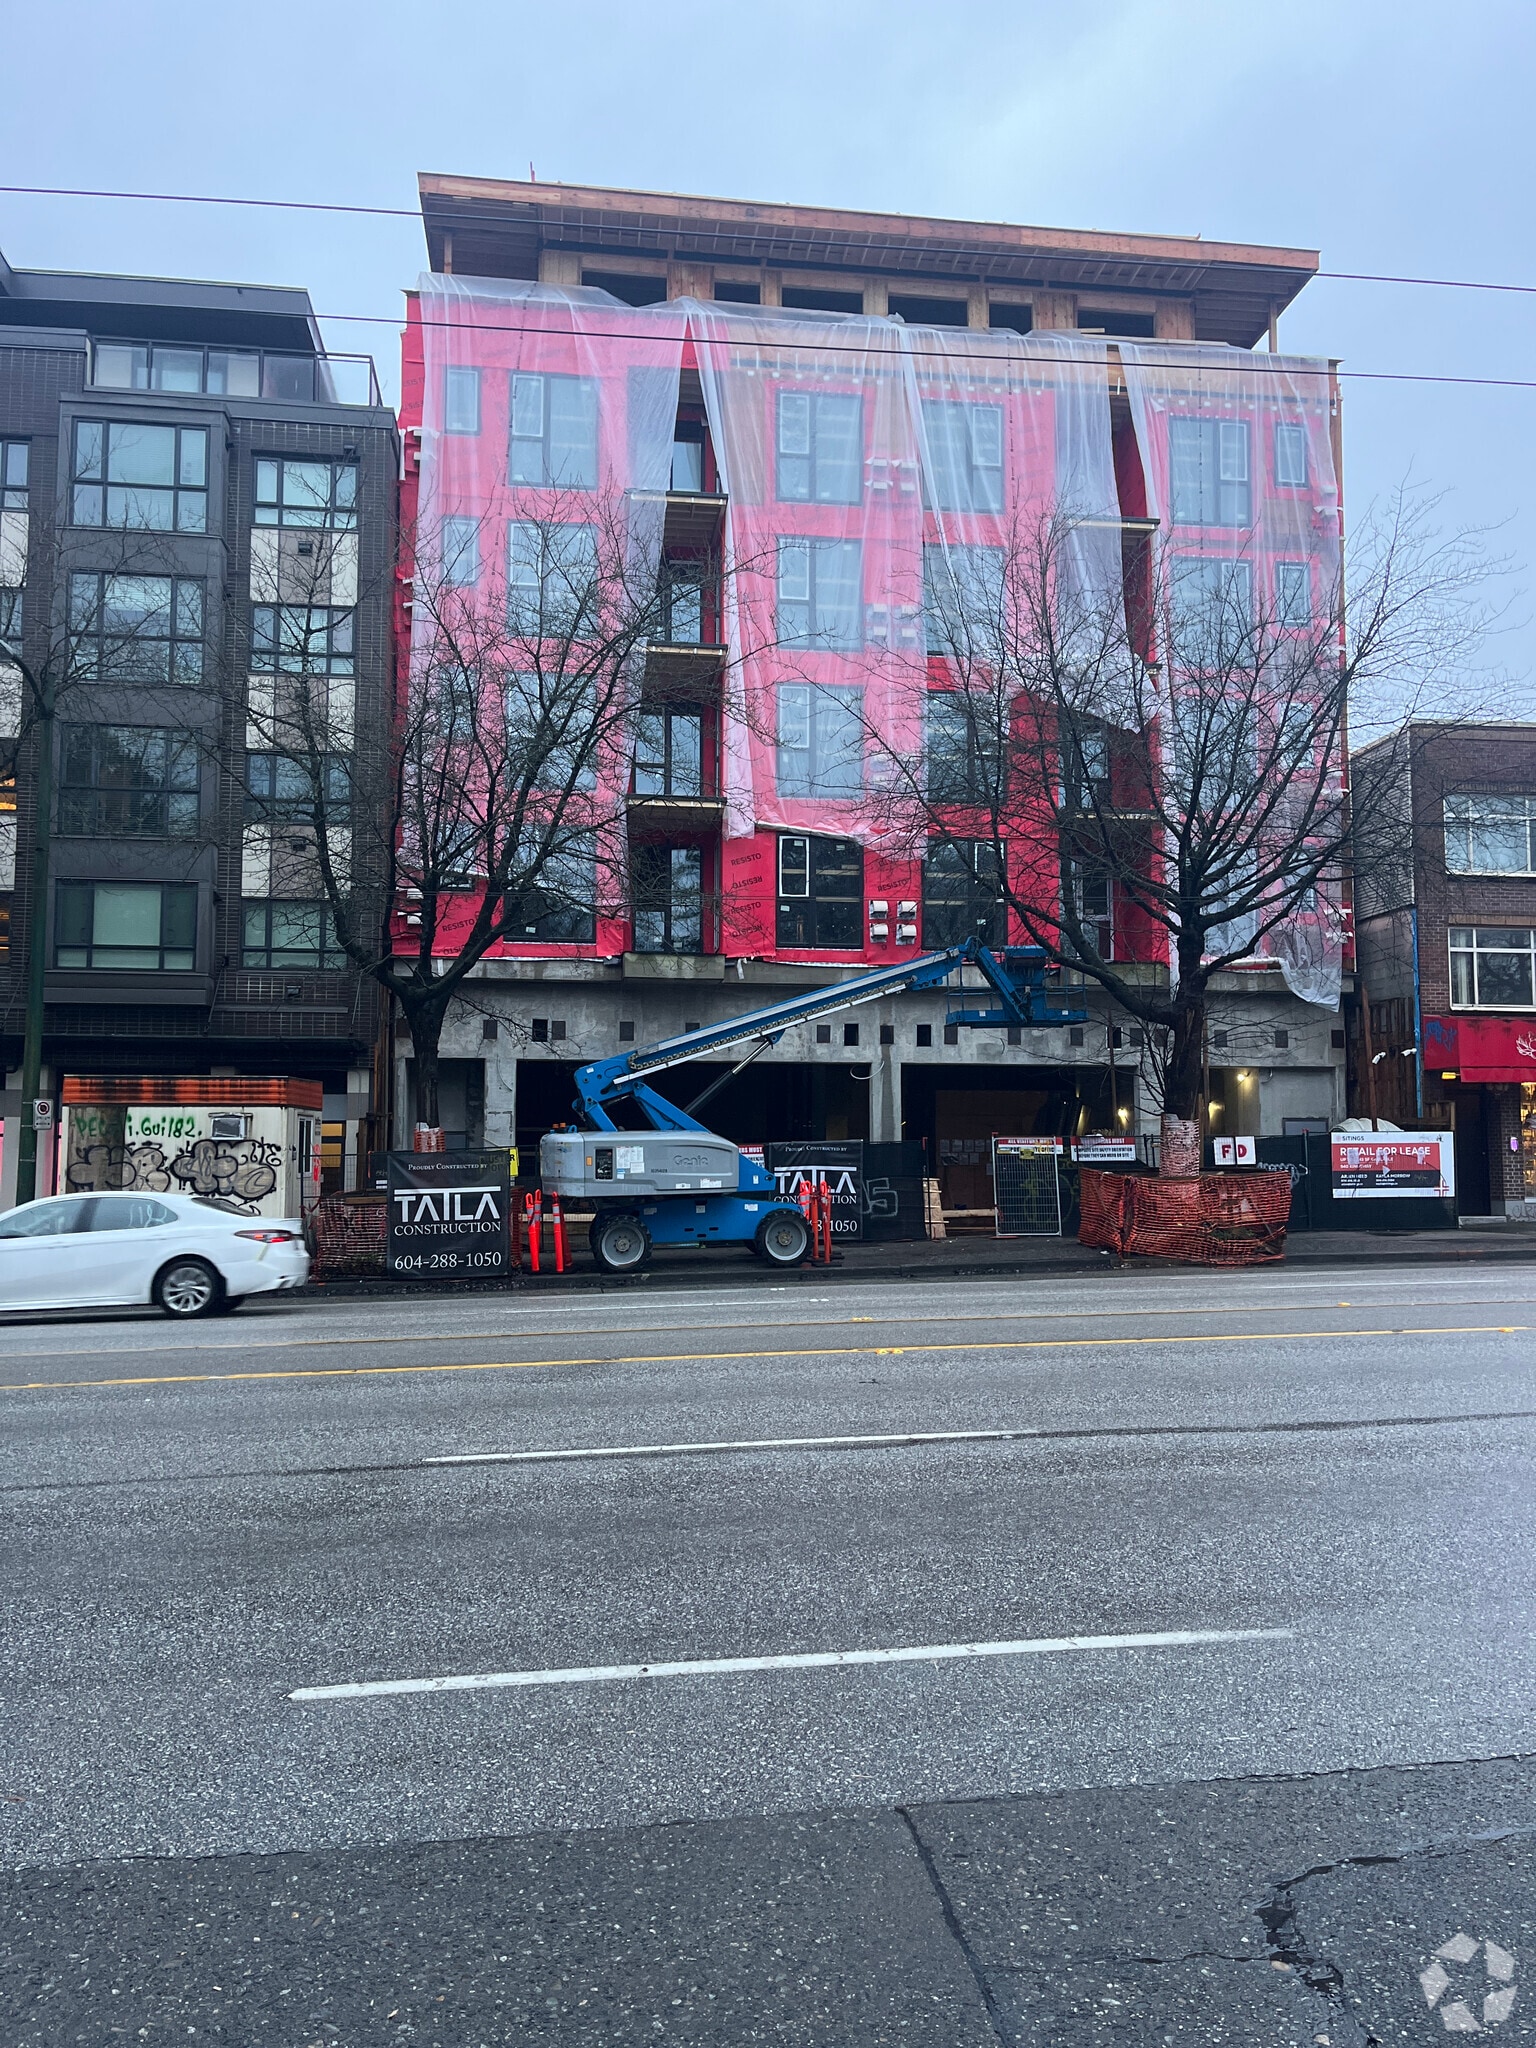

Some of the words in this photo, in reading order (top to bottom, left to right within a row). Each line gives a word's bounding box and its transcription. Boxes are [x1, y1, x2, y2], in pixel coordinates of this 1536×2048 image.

[731, 852, 762, 866] RESISTO
[732, 875, 763, 889] RESISTO
[877, 878, 909, 892] RESISTO
[442, 918, 475, 932] RESISTO
[1340, 1147, 1375, 1156] RAIL
[673, 1155, 708, 1166] Genie
[774, 1165, 857, 1194] TATLA
[394, 1186, 501, 1222] TATLA
[774, 1194, 857, 1205] CONTION
[394, 1221, 501, 1236] CONSTRUCTION
[394, 1252, 502, 1270] 604-288-1050
